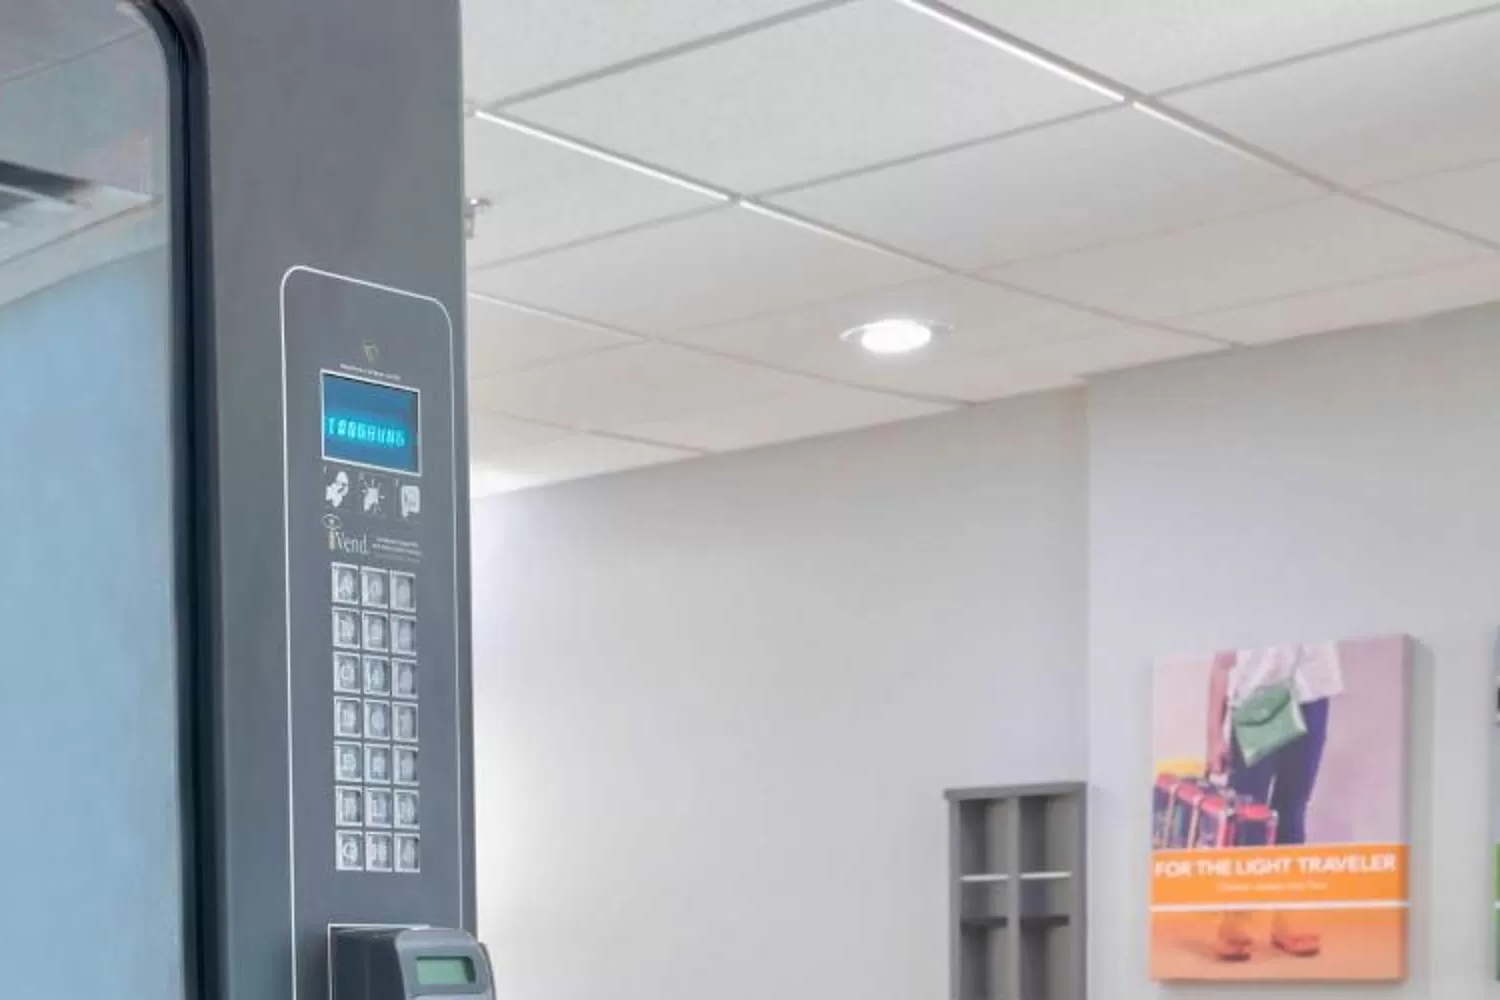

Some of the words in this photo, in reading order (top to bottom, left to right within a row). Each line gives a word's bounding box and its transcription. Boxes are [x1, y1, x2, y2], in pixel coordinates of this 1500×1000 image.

[1154, 860, 1192, 878] FOR
[1197, 858, 1232, 877] THE
[1235, 856, 1293, 875] LIGHT
[1297, 852, 1397, 873] TRAVELER
